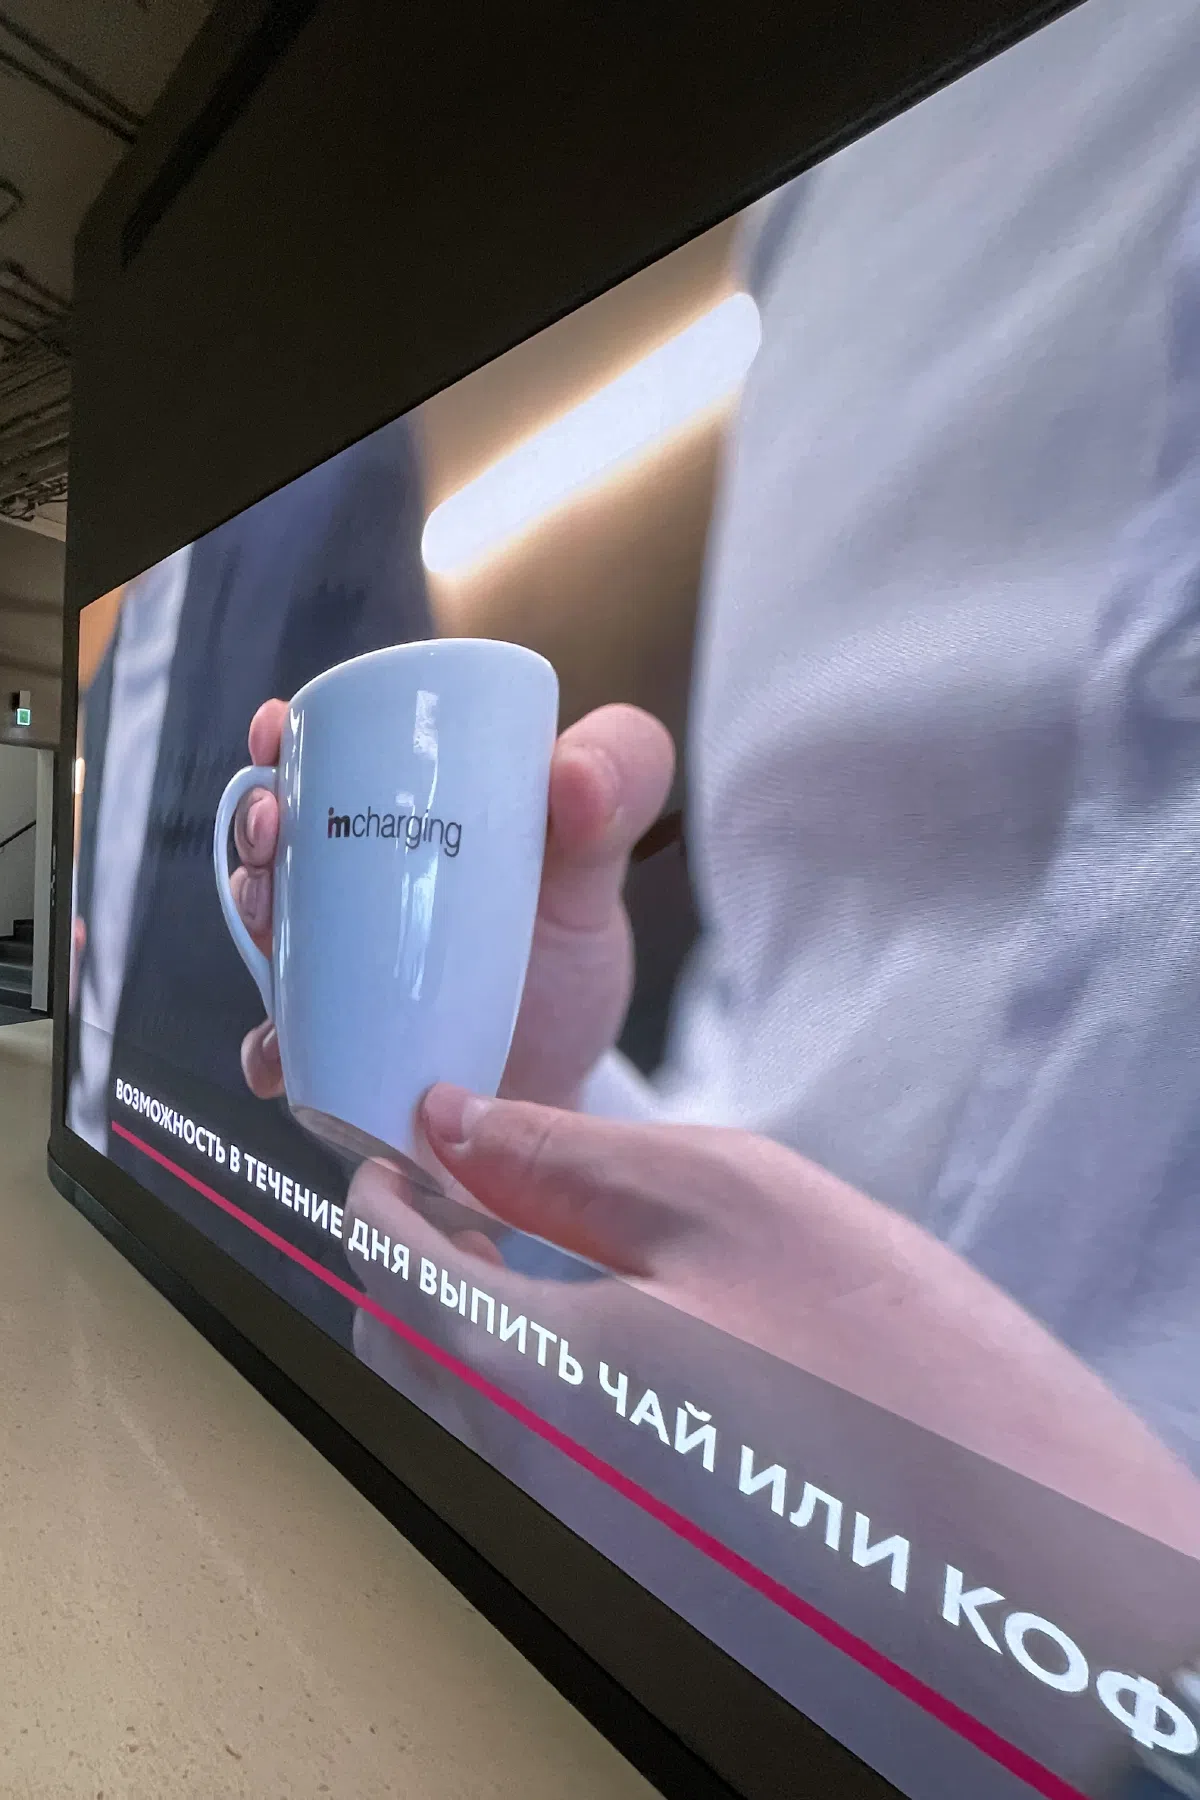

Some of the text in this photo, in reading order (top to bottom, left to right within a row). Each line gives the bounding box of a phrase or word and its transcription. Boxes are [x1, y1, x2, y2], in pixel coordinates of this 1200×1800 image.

[116, 1078, 1199, 1755] ВОЗМОЖНОСТЬ В ТЕЧЕНИЕ ДНЯ ВЫПИТЬ ЧАЙ ИЛИ КОФ
